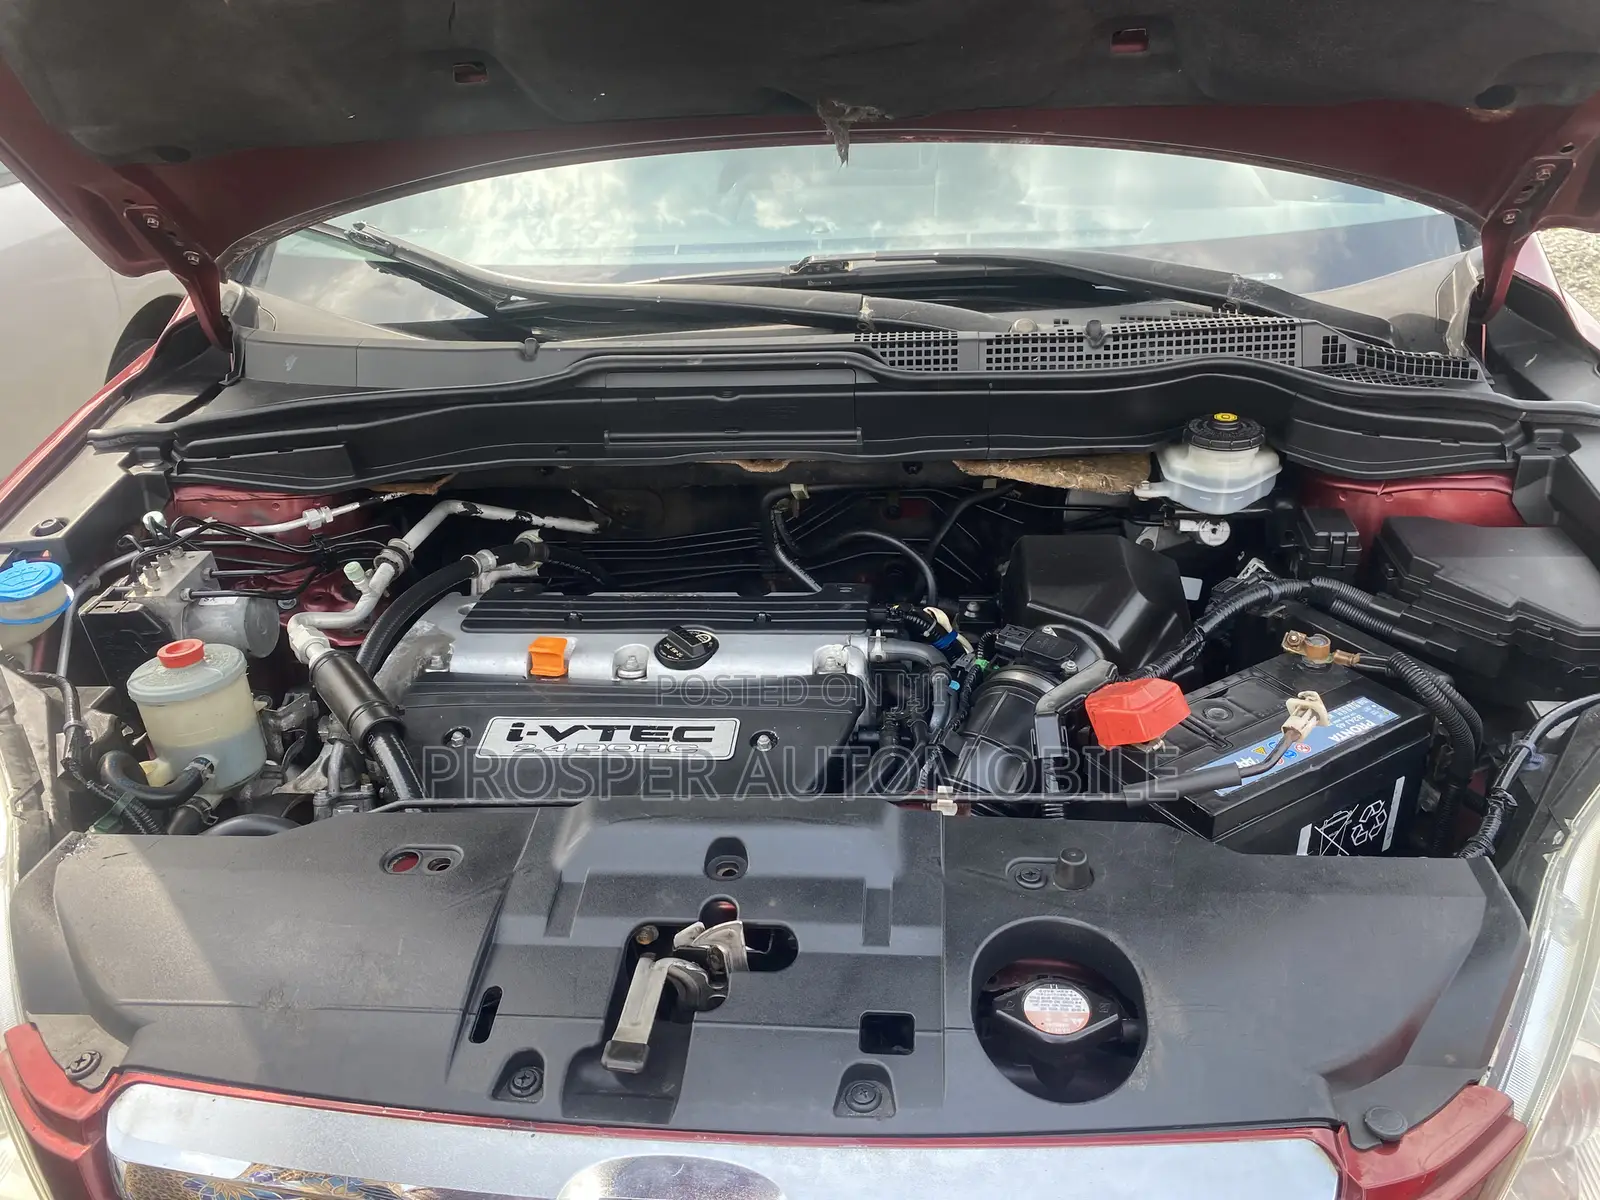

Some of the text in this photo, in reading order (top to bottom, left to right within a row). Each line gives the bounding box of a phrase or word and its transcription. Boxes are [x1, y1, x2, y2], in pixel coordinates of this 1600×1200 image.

[506, 722, 716, 743] i-VTEC
[1327, 719, 1377, 742] PRONTA
[512, 743, 699, 754] 2.4 DOHC
